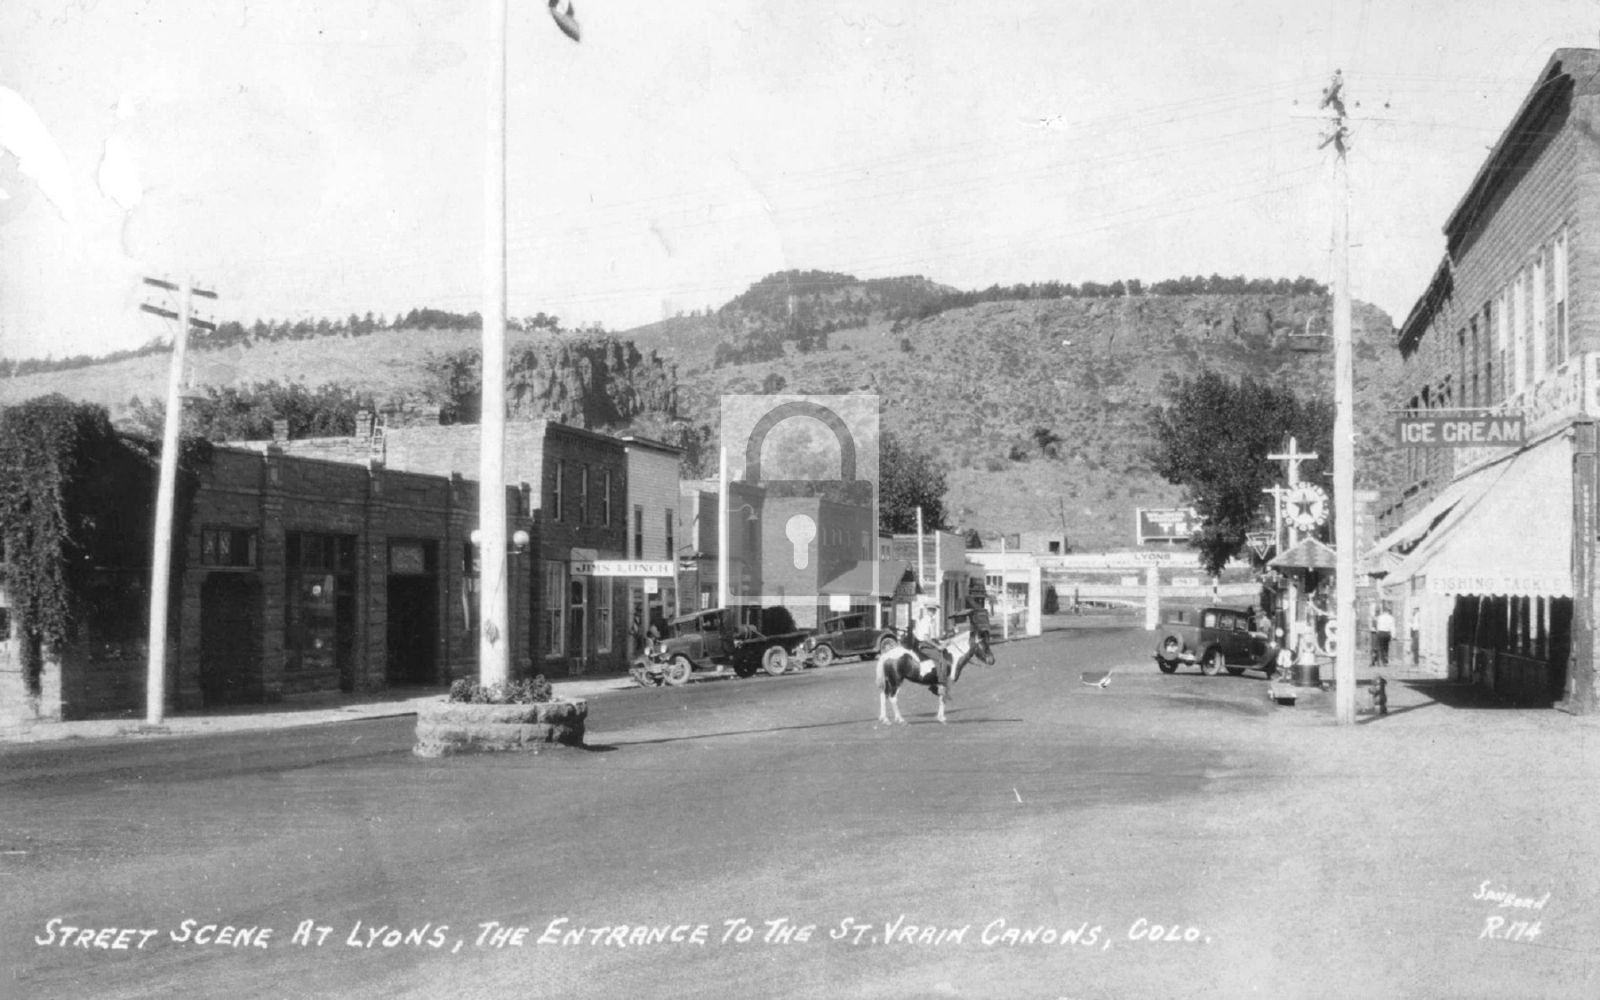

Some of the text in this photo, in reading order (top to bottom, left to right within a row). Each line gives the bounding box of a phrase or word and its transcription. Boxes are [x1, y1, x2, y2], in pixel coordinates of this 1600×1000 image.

[1400, 420, 1522, 443] ICE CREAM
[1134, 553, 1171, 561] LYONS
[617, 563, 669, 573] LUNCH
[1432, 577, 1562, 591] FISHING TACKLE
